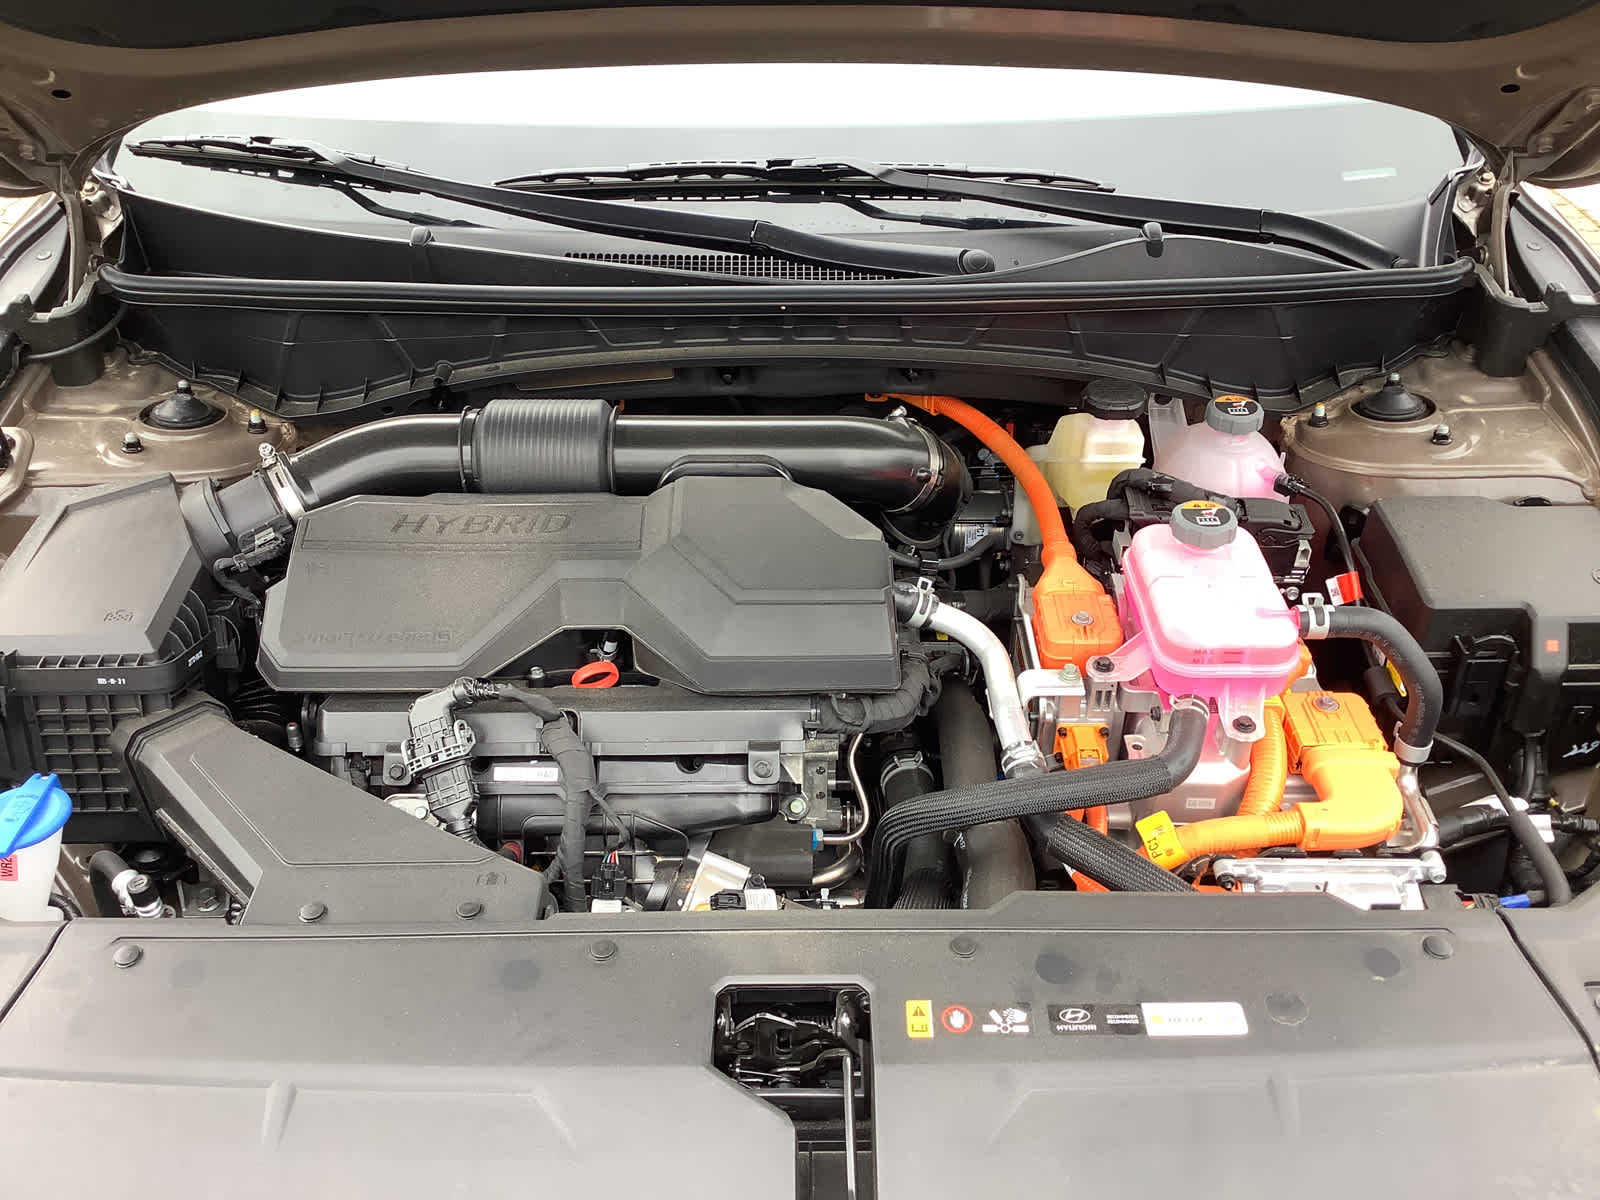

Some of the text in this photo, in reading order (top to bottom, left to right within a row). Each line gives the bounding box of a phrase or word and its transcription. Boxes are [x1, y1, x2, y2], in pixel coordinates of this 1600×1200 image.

[389, 513, 572, 535] HYBRID
[1147, 837, 1163, 859] PC1
[1056, 1024, 1097, 1032] HYUNDAI
